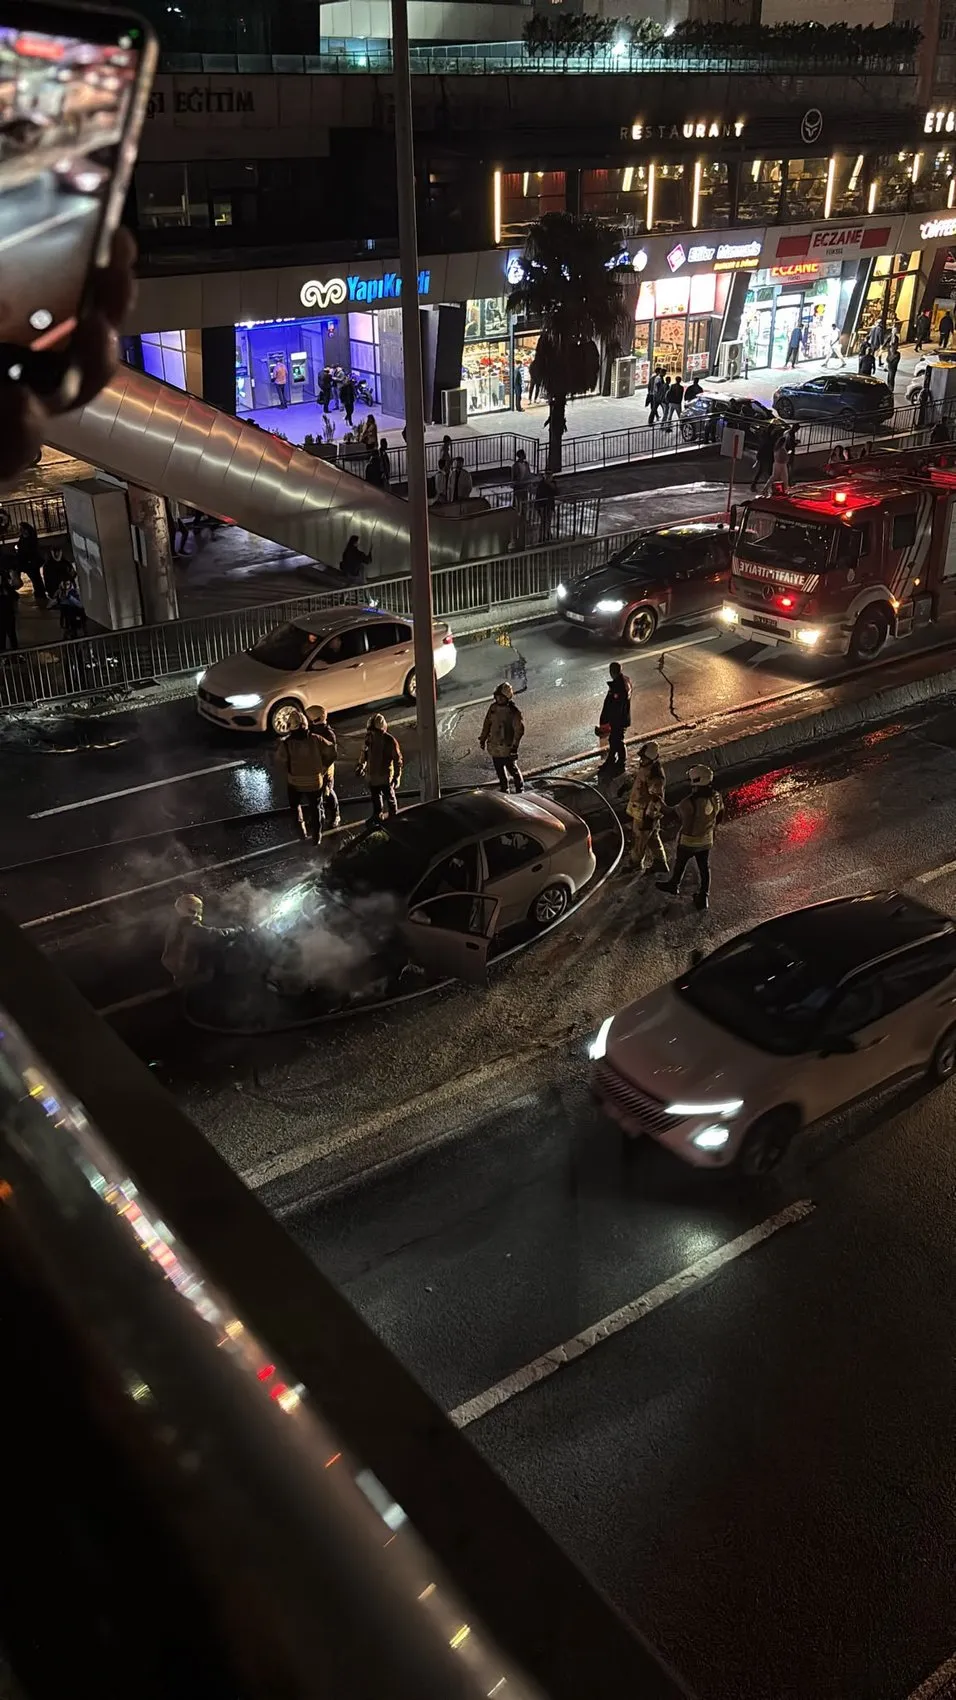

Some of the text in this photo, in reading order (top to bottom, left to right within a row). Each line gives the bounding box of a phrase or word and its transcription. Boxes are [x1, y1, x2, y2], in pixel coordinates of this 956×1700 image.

[619, 122, 745, 141] RESTAURANT
[812, 229, 863, 248] ECZANE
[771, 262, 819, 277] ECZANE
[346, 270, 431, 303] YapıKrdi
